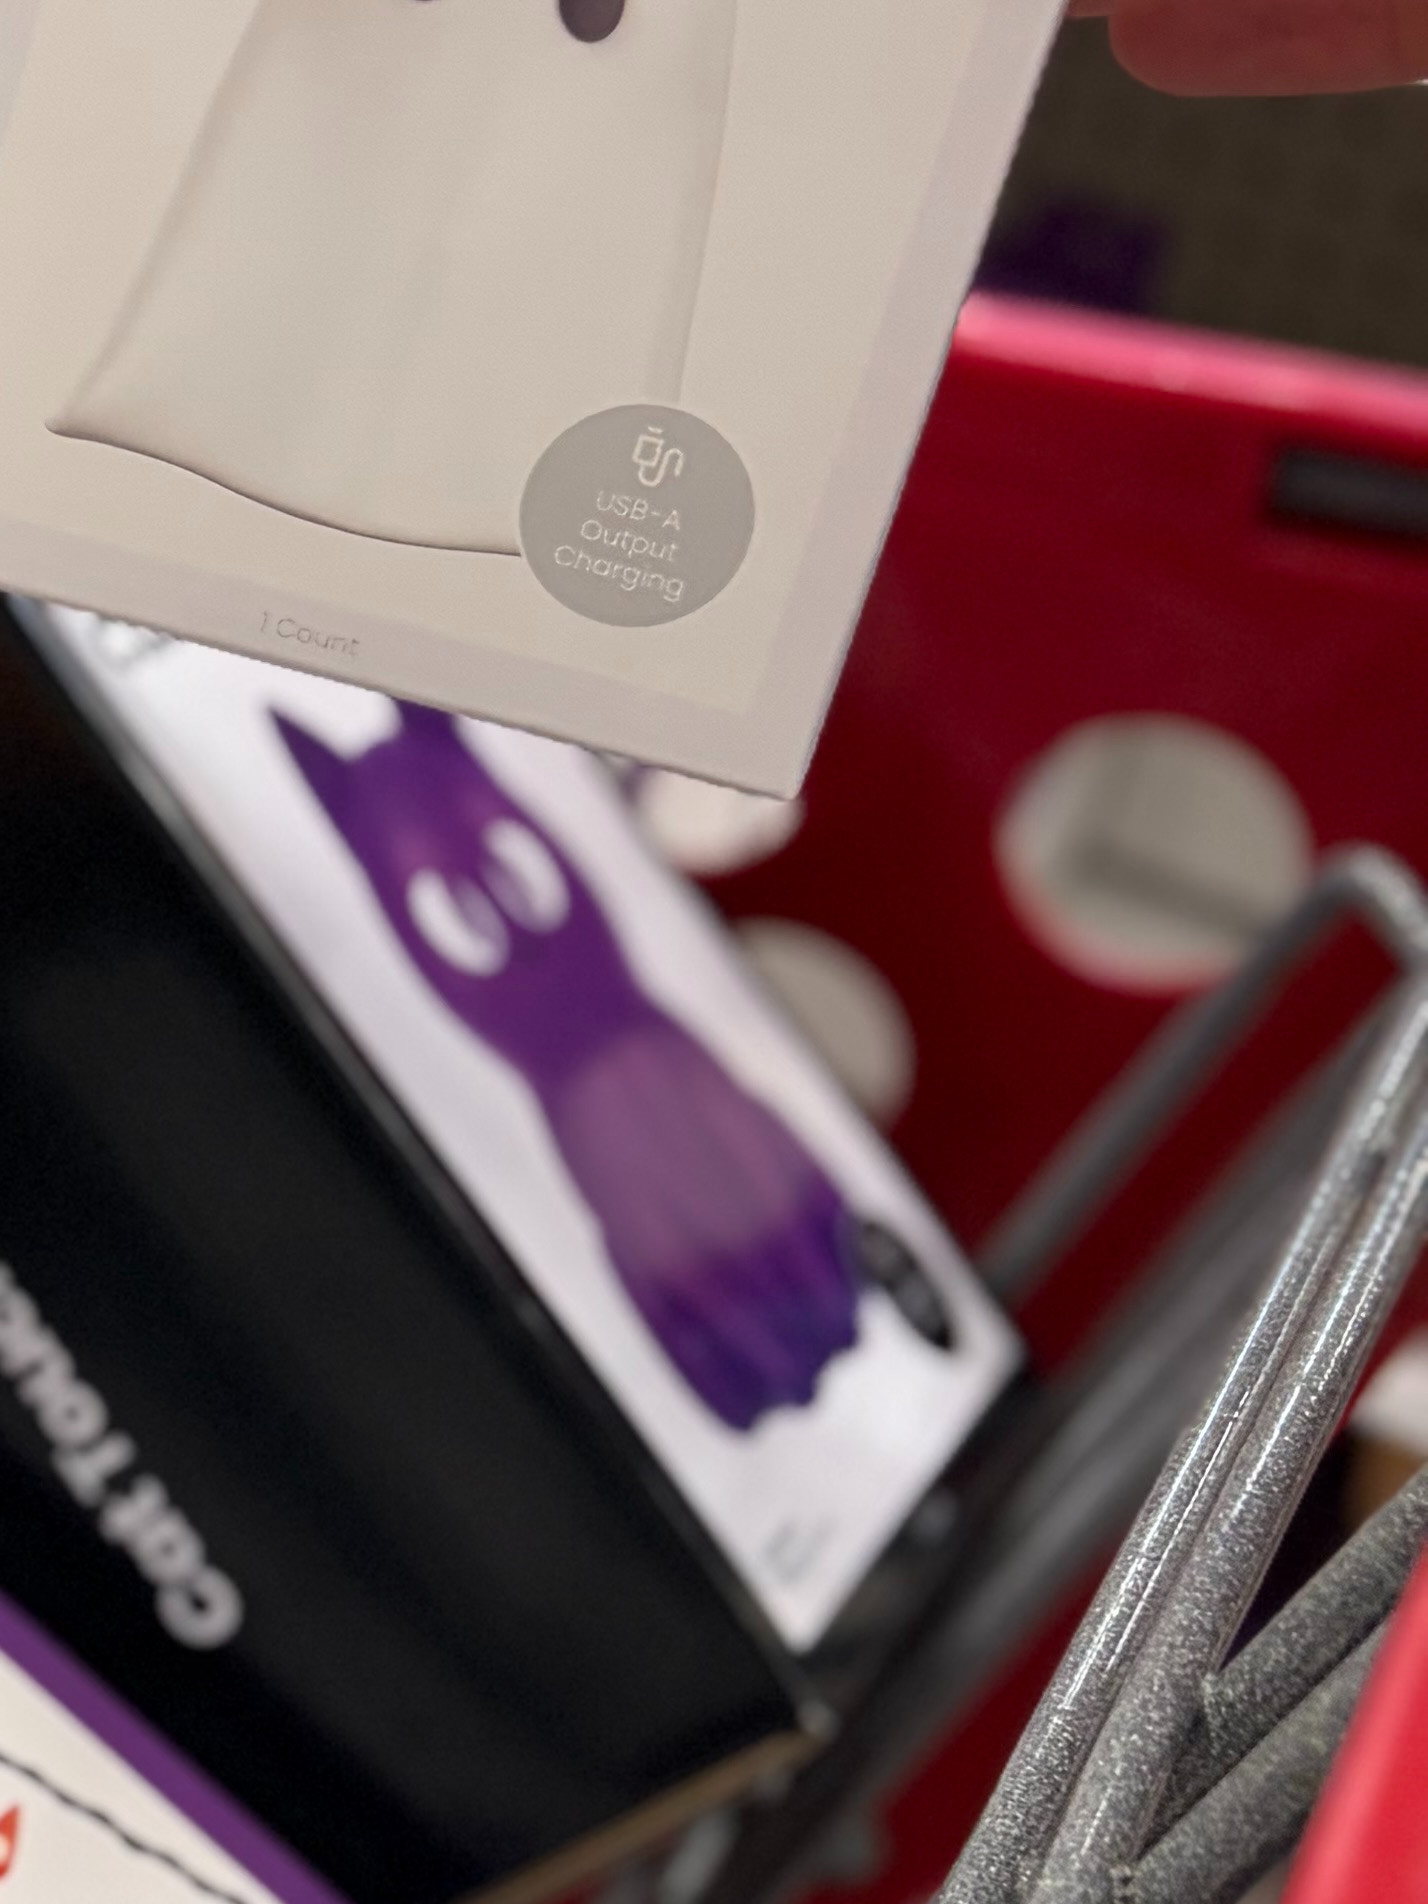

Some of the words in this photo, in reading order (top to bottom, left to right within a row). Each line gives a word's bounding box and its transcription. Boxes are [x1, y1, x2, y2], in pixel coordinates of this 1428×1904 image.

[596, 489, 682, 532] USB-A
[579, 518, 679, 563] Output
[553, 543, 686, 603] Charging
[258, 611, 269, 633] 1
[276, 616, 361, 659] Count
[99, 1474, 242, 1648] Cat
